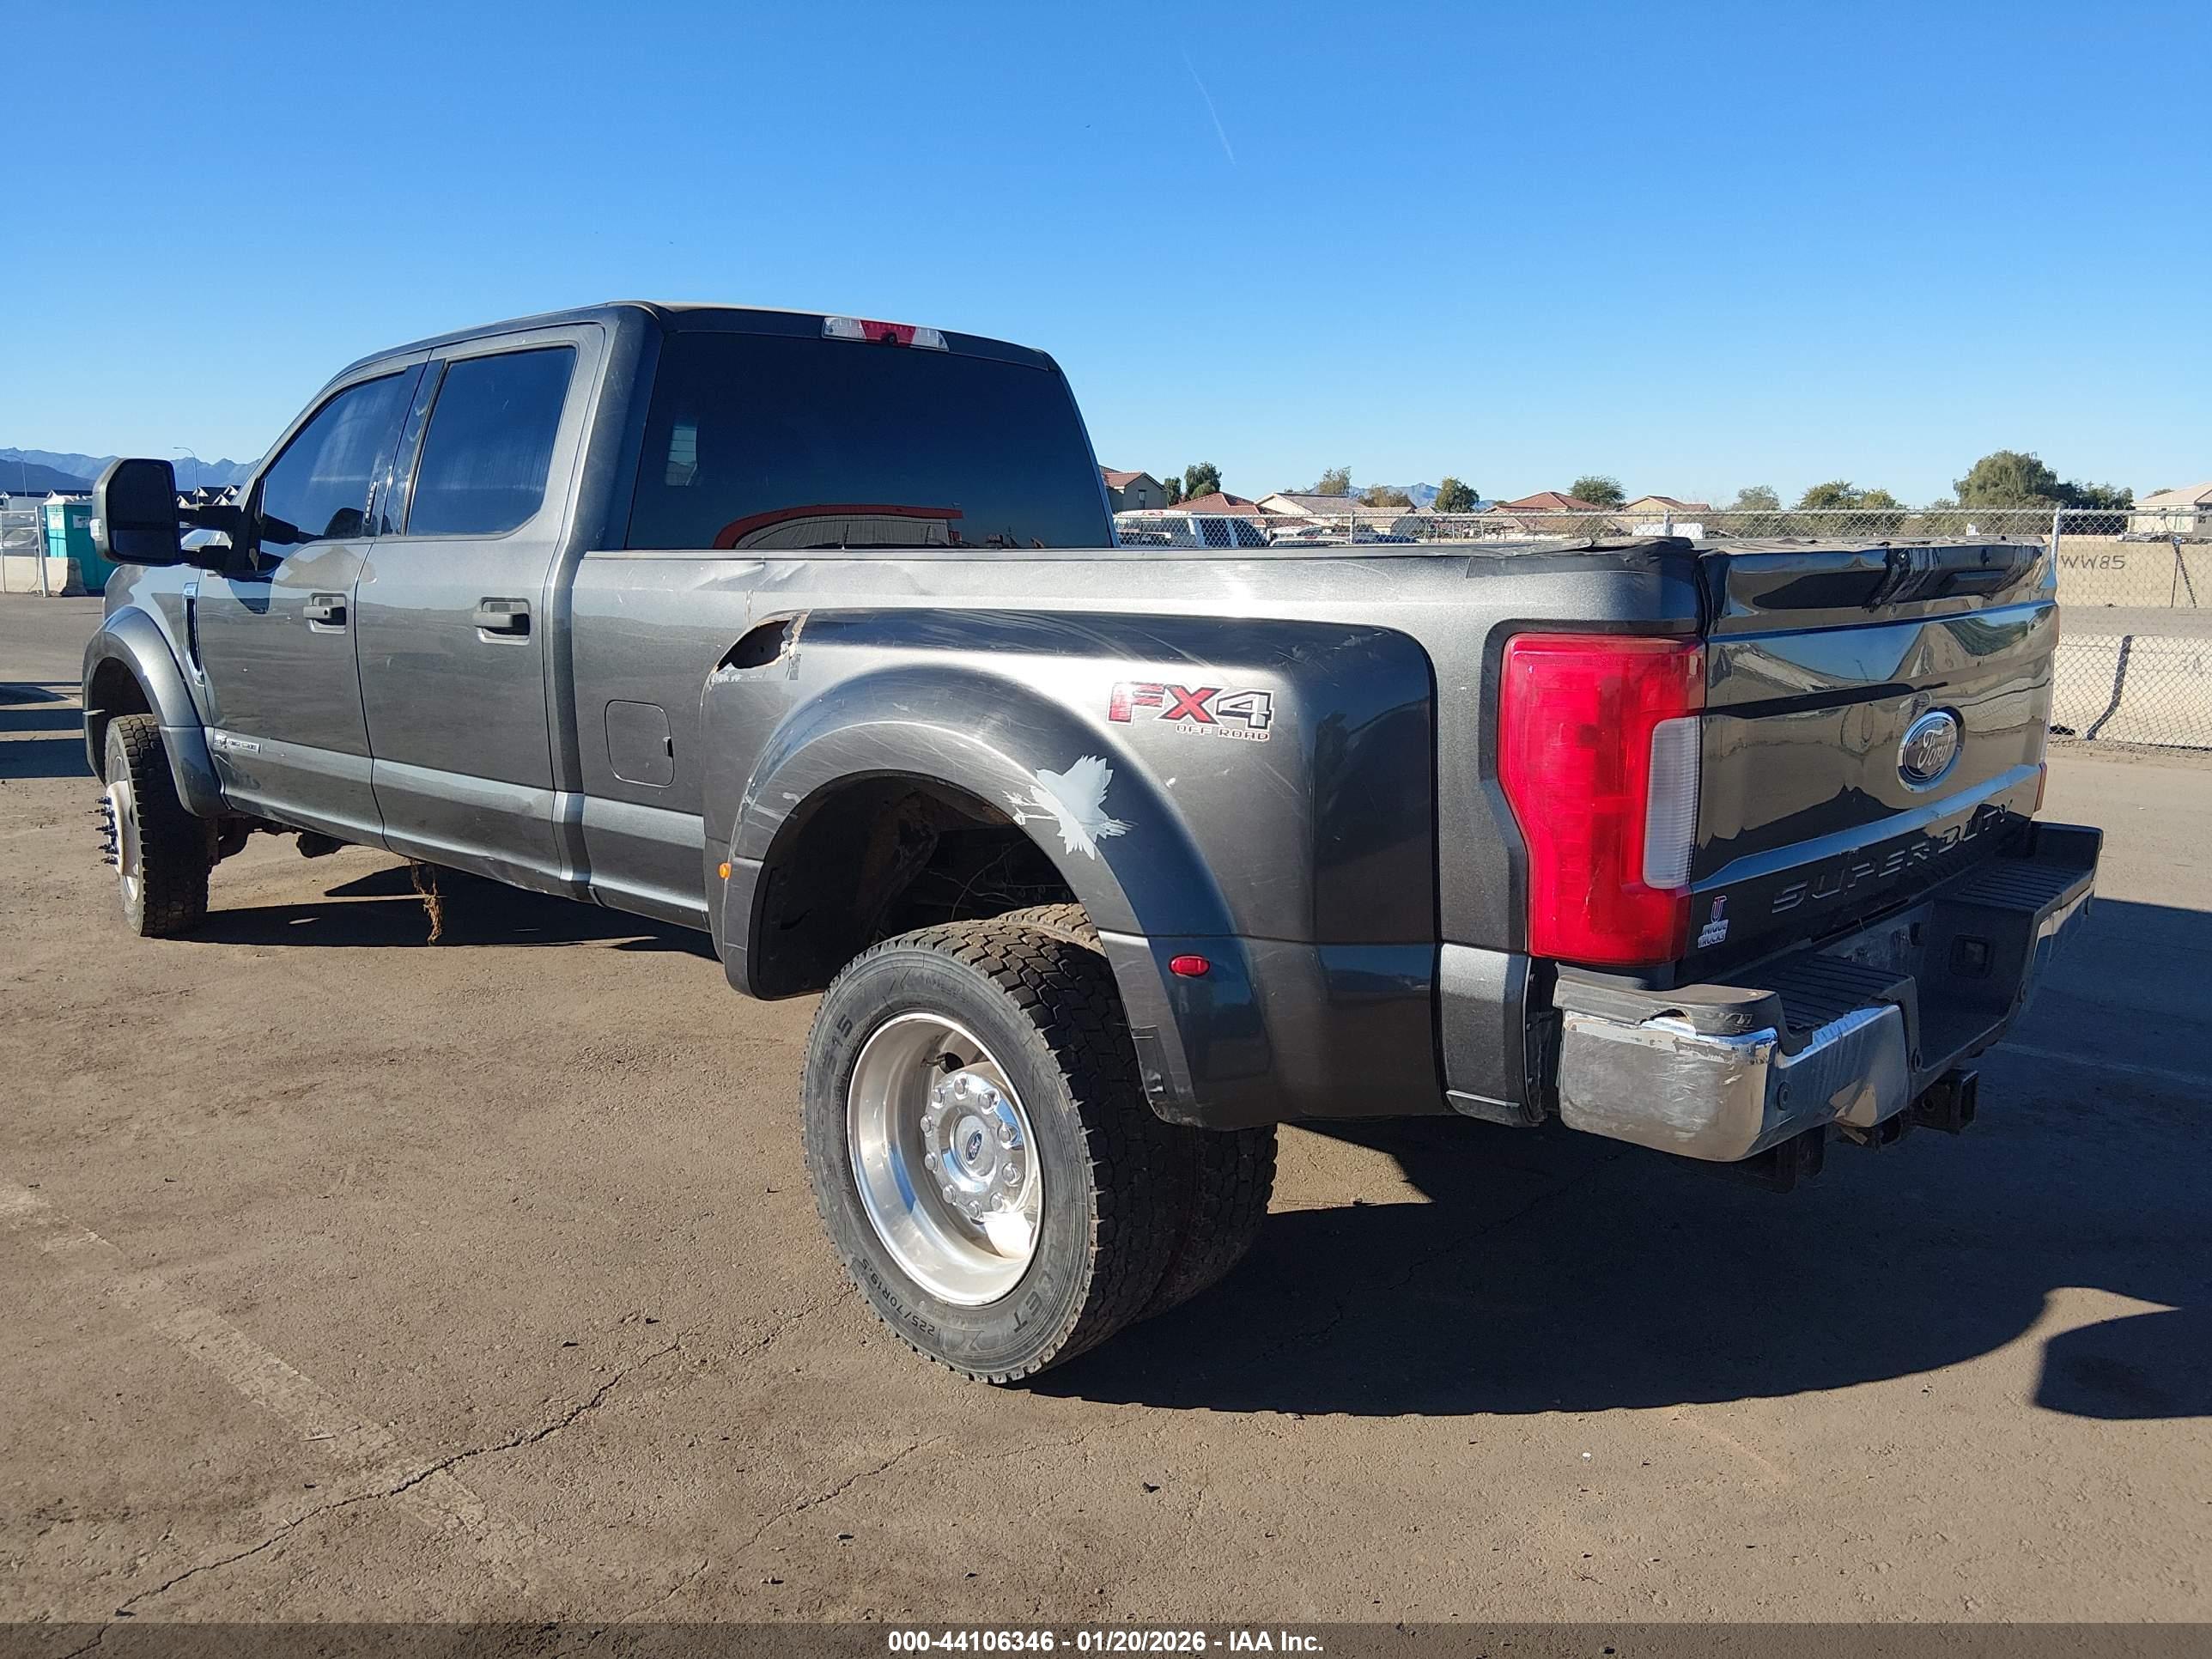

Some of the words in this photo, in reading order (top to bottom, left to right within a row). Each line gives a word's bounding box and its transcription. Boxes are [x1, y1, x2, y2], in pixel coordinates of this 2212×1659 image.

[2061, 555, 2125, 569] WW85
[1108, 683, 1274, 731] FX4
[1176, 724, 1212, 737] OFF
[1218, 728, 1270, 741] ROAD
[1917, 728, 1951, 769] Ford
[1771, 841, 1931, 914] SUPER
[1938, 799, 2014, 854] DUTY
[862, 1258, 936, 1337] 225/70R19.5
